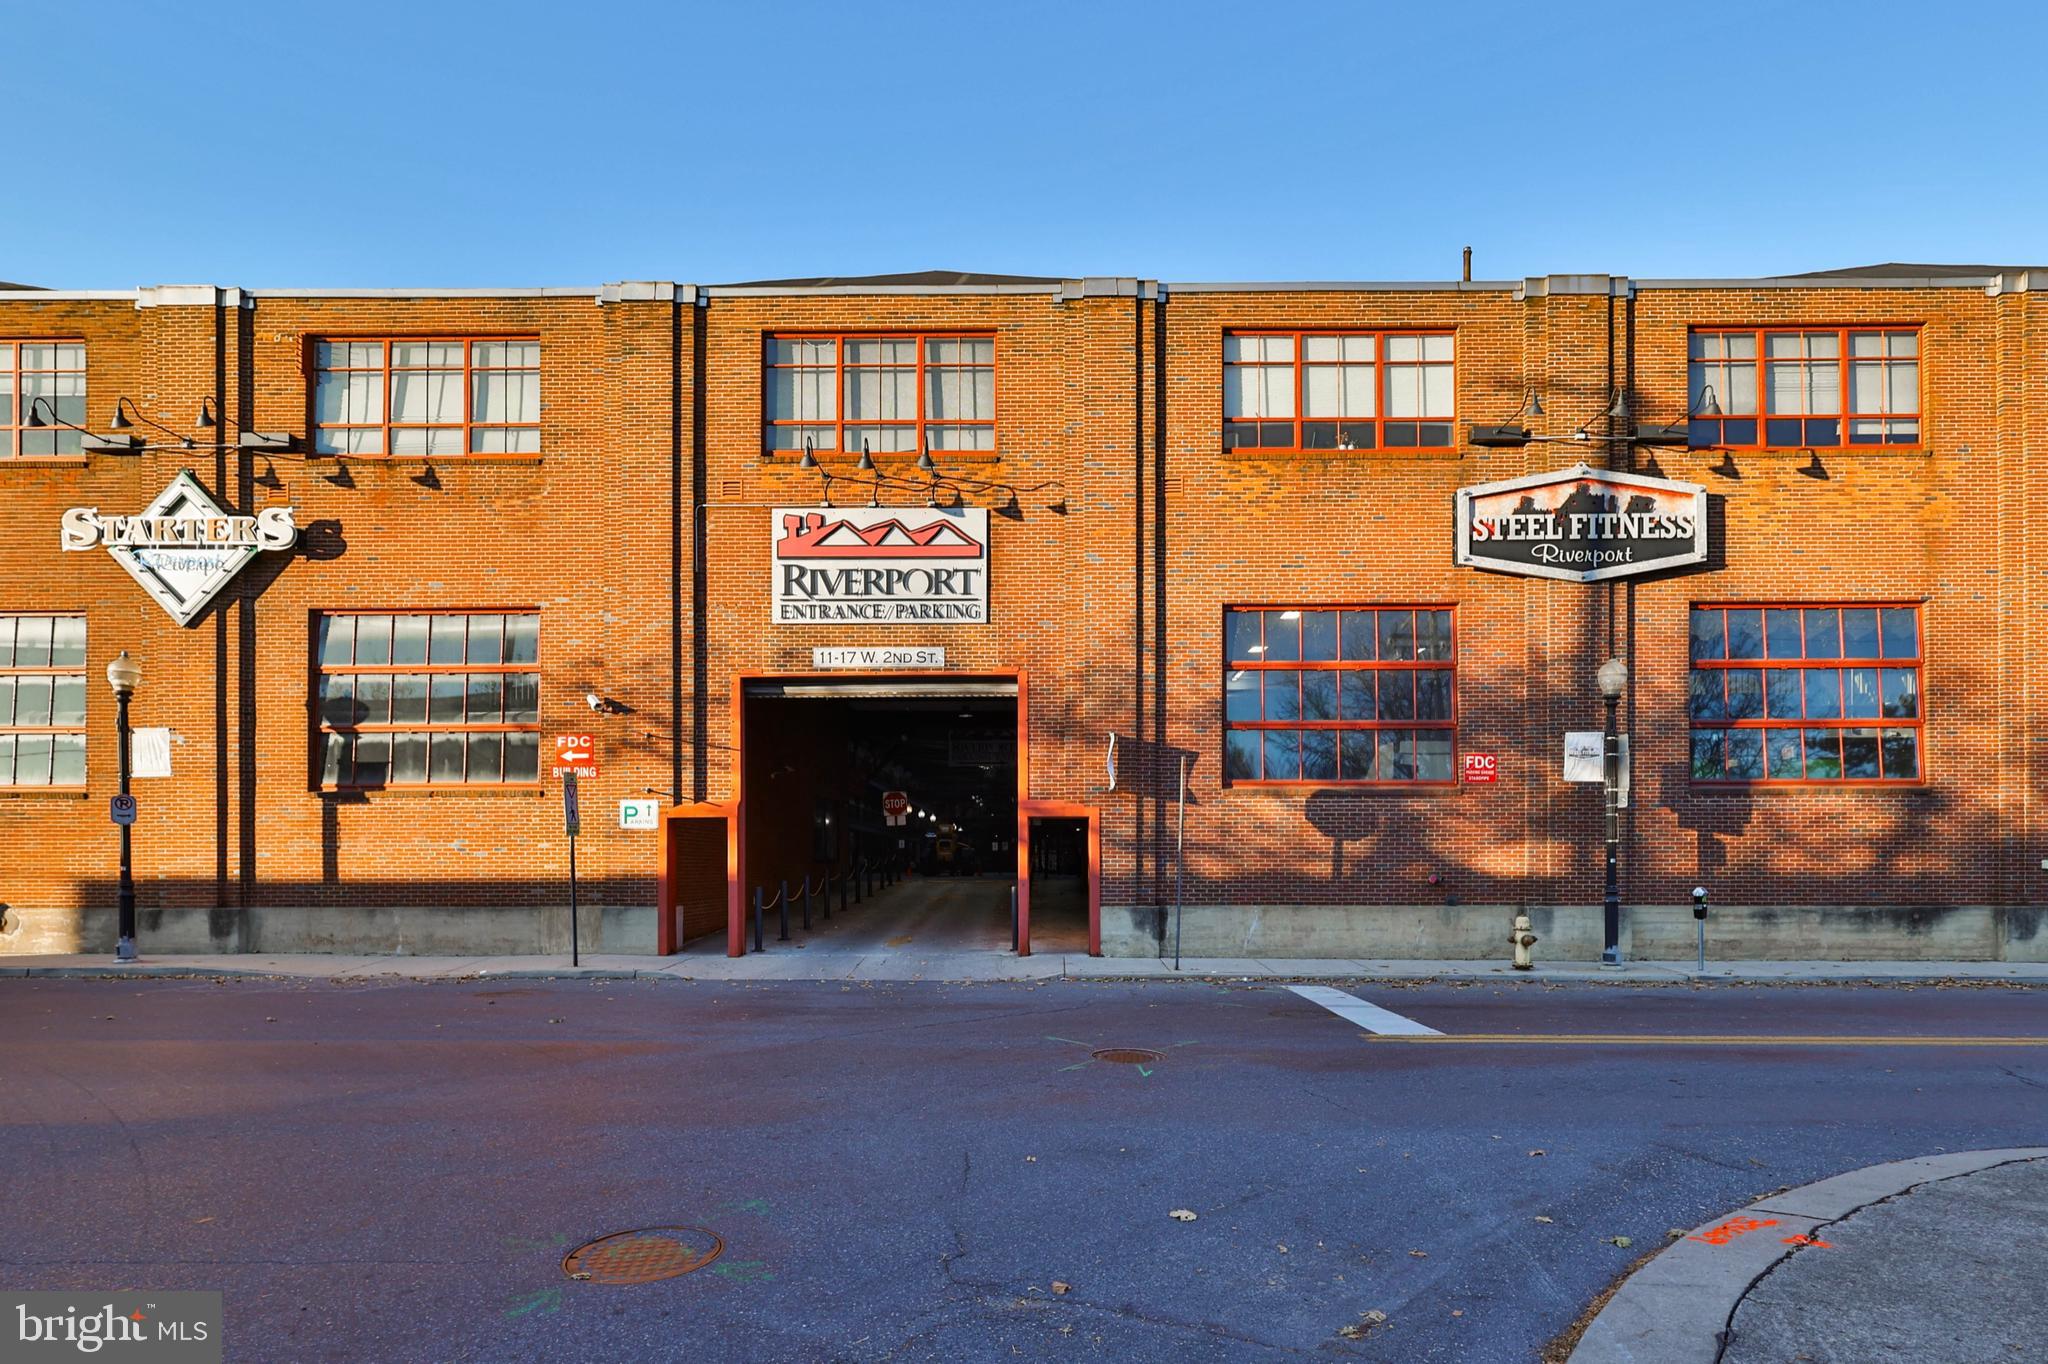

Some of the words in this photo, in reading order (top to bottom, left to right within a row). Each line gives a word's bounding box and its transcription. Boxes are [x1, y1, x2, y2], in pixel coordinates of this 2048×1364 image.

[61, 507, 297, 552] STARTERS
[1472, 513, 1563, 542] STEEL
[1569, 513, 1695, 541] FITNESS
[1531, 543, 1633, 567] Riverport
[781, 564, 982, 601] RIVERPORT
[820, 651, 857, 664] 11-17
[860, 651, 878, 664] W.
[883, 651, 913, 664] 2ND
[916, 651, 938, 664] ST.
[557, 736, 591, 748] FDC
[1466, 755, 1495, 769] FDC
[885, 799, 906, 809] STOP
